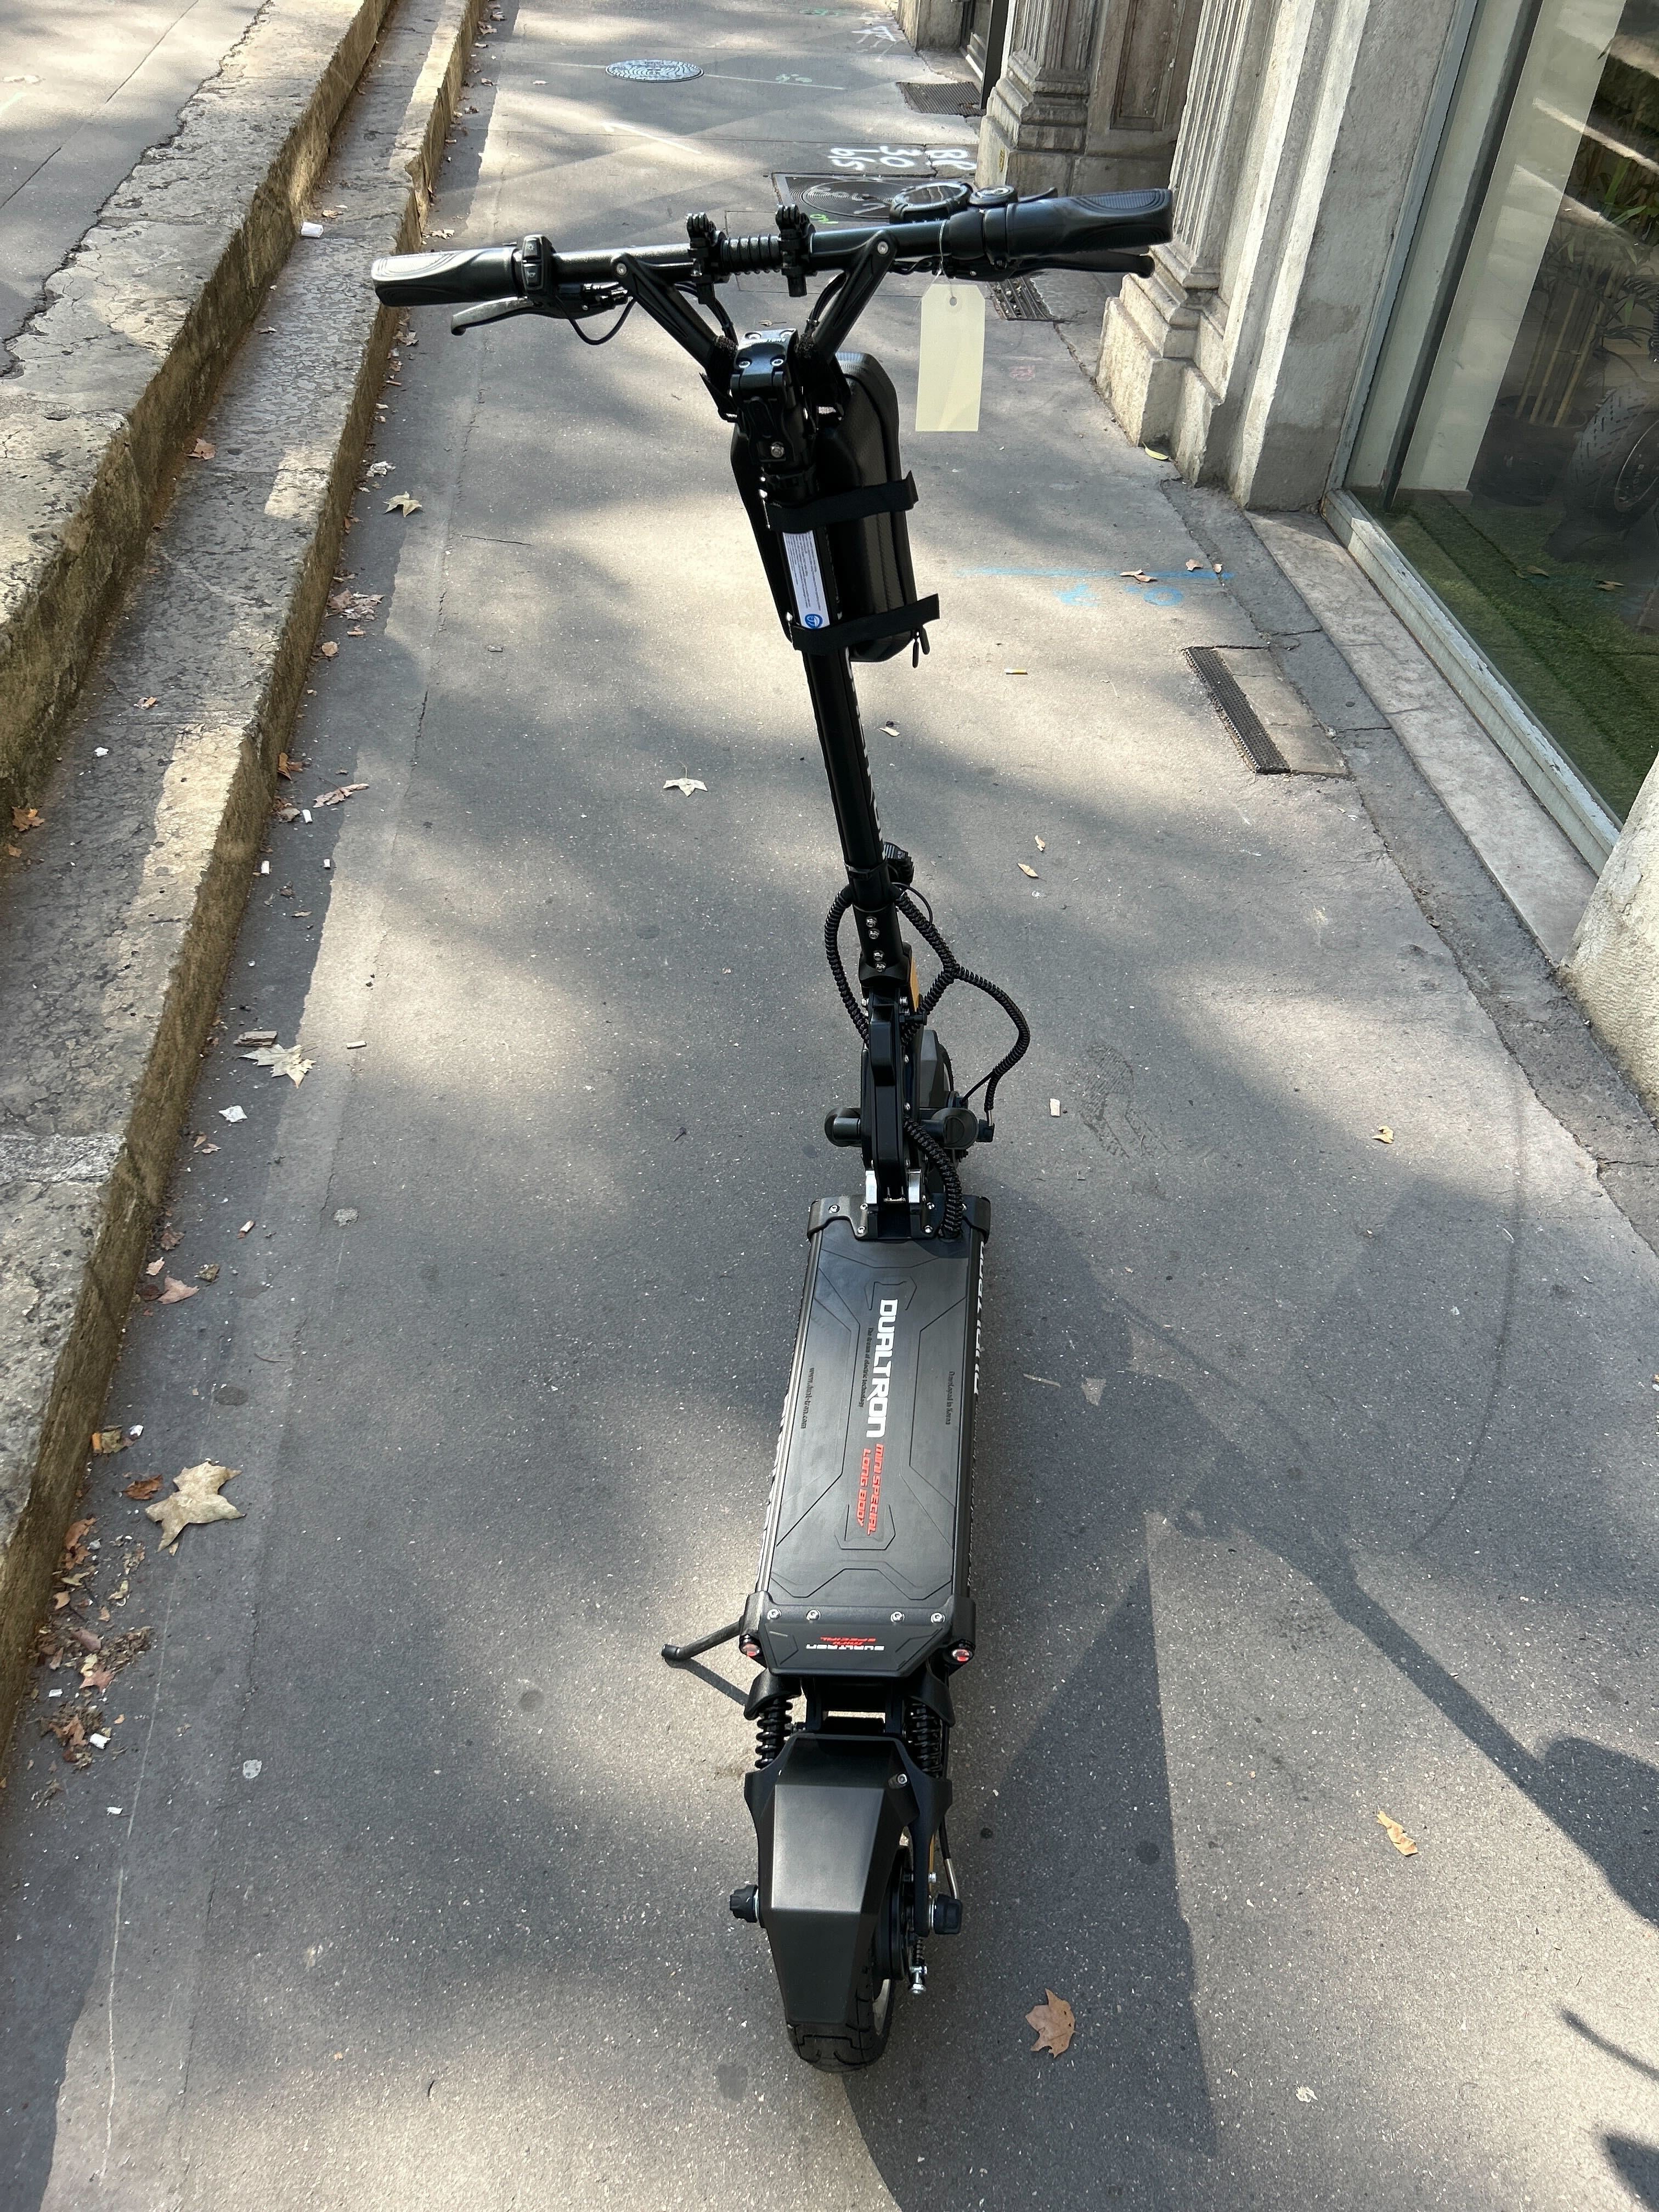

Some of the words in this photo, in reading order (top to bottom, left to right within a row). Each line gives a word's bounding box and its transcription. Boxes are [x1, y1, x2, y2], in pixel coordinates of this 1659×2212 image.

[879, 145, 924, 168] 30
[866, 1299, 899, 1438] DUALTRON
[858, 1379, 868, 1408] technology
[860, 1448, 871, 1487] LONG
[873, 1444, 884, 1474] MINI
[856, 1488, 868, 1528] BODY
[867, 1474, 881, 1536] SPECIAL
